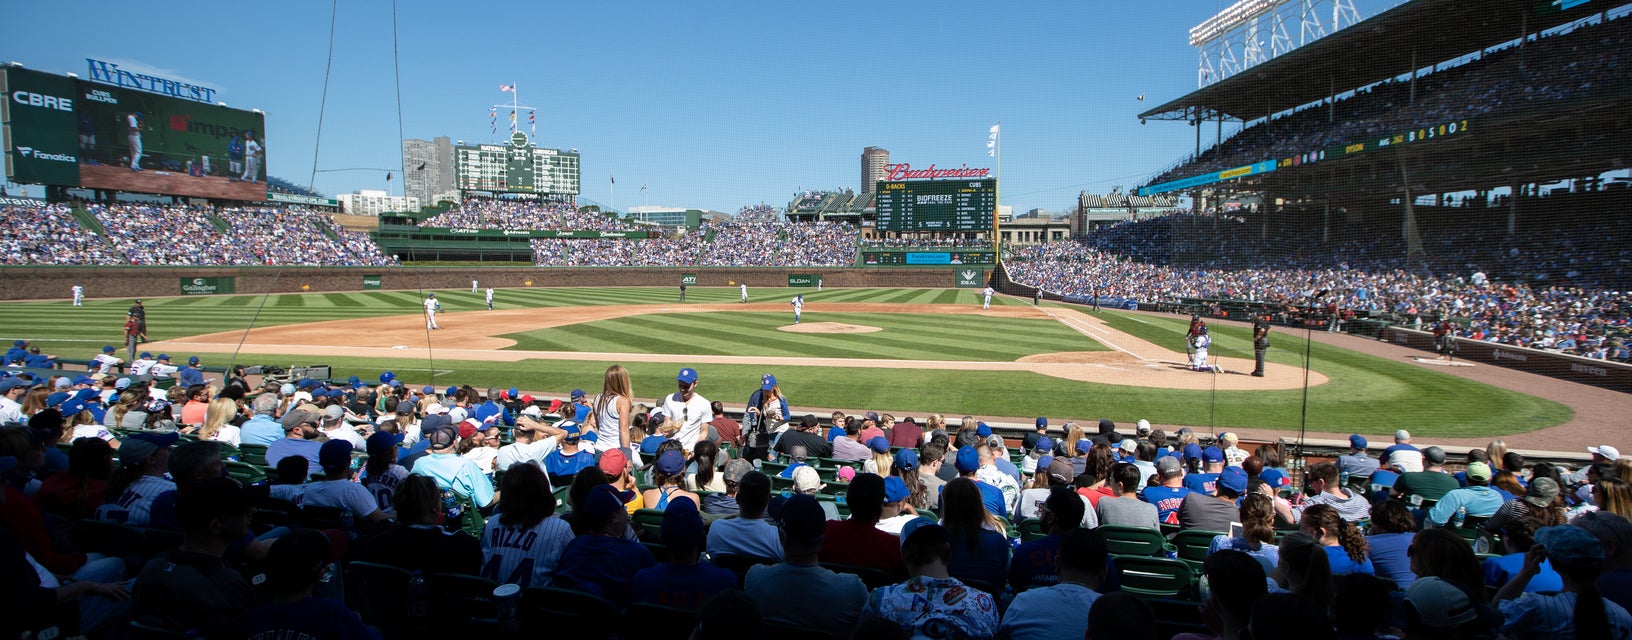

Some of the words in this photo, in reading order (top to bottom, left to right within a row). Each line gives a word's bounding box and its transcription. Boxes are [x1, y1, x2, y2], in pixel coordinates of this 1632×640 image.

[86, 58, 216, 103] WINTRUST
[13, 90, 73, 112] CBRE
[85, 94, 118, 104] BULLPEN
[91, 89, 111, 98] CUBS
[1409, 131, 1415, 142] B
[1429, 127, 1435, 138] S
[1461, 120, 1468, 131] 2
[33, 150, 76, 162] Fanatics
[884, 163, 991, 181] Budweiser
[183, 284, 217, 292] Gallagher
[490, 526, 539, 552] RIZZO
